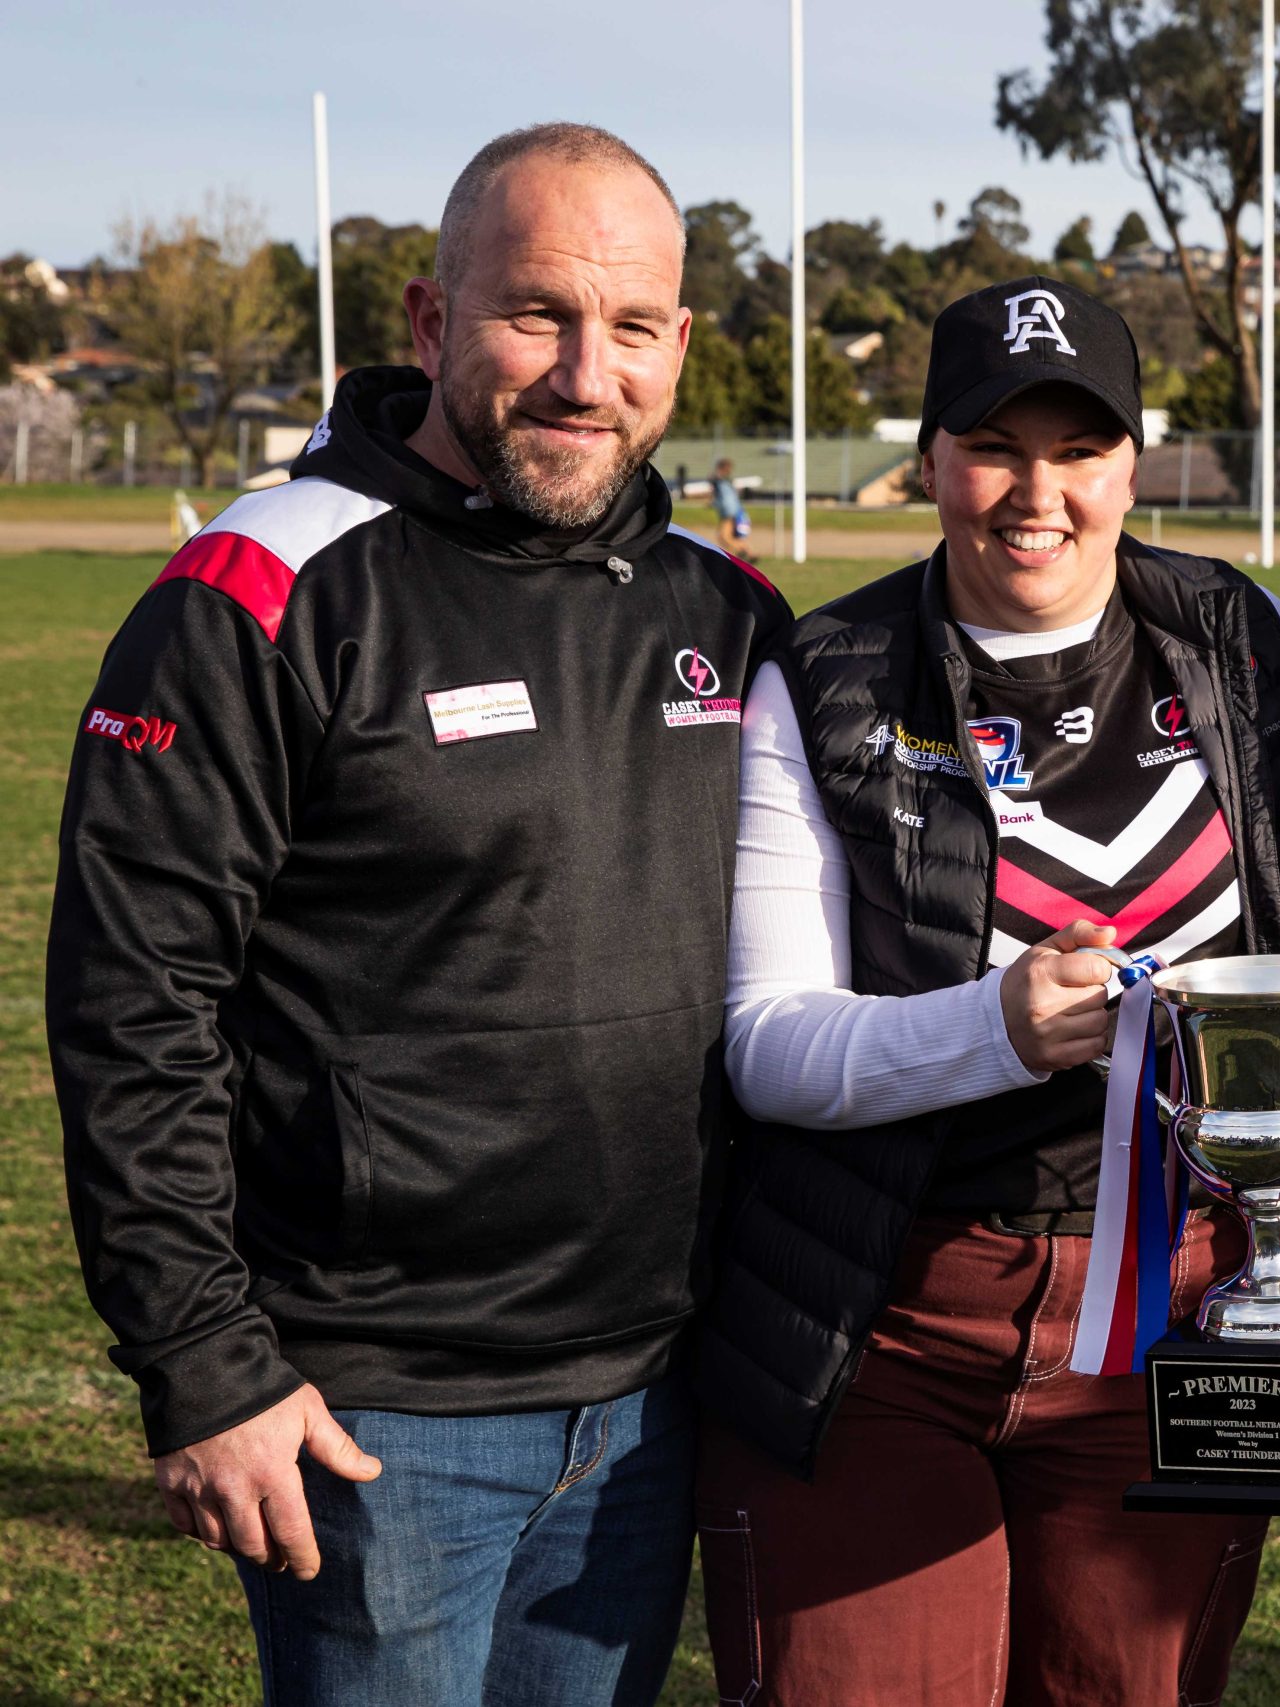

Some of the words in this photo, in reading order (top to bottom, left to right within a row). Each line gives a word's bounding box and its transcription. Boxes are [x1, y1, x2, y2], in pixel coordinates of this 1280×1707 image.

[433, 704, 477, 719] Melbourne
[477, 702, 495, 711] Lash
[496, 698, 527, 710] Supplies
[662, 700, 702, 715] CASEY
[702, 698, 741, 712] THUND
[500, 710, 530, 719] Professional
[667, 713, 704, 726] WOMEN'S
[894, 739, 965, 767] CONSTRUCT
[1137, 745, 1175, 762] CASEY
[893, 806, 925, 828] KATE
[1000, 812, 1035, 825] Bank
[1229, 1398, 1257, 1410] 2023
[1169, 1418, 1212, 1427] SOUTHERN
[1213, 1419, 1255, 1428] FOOTBALL
[1216, 1430, 1246, 1438] Women's
[1247, 1431, 1274, 1439] Division
[1251, 1440, 1259, 1448] by
[1196, 1449, 1230, 1459] CASEY
